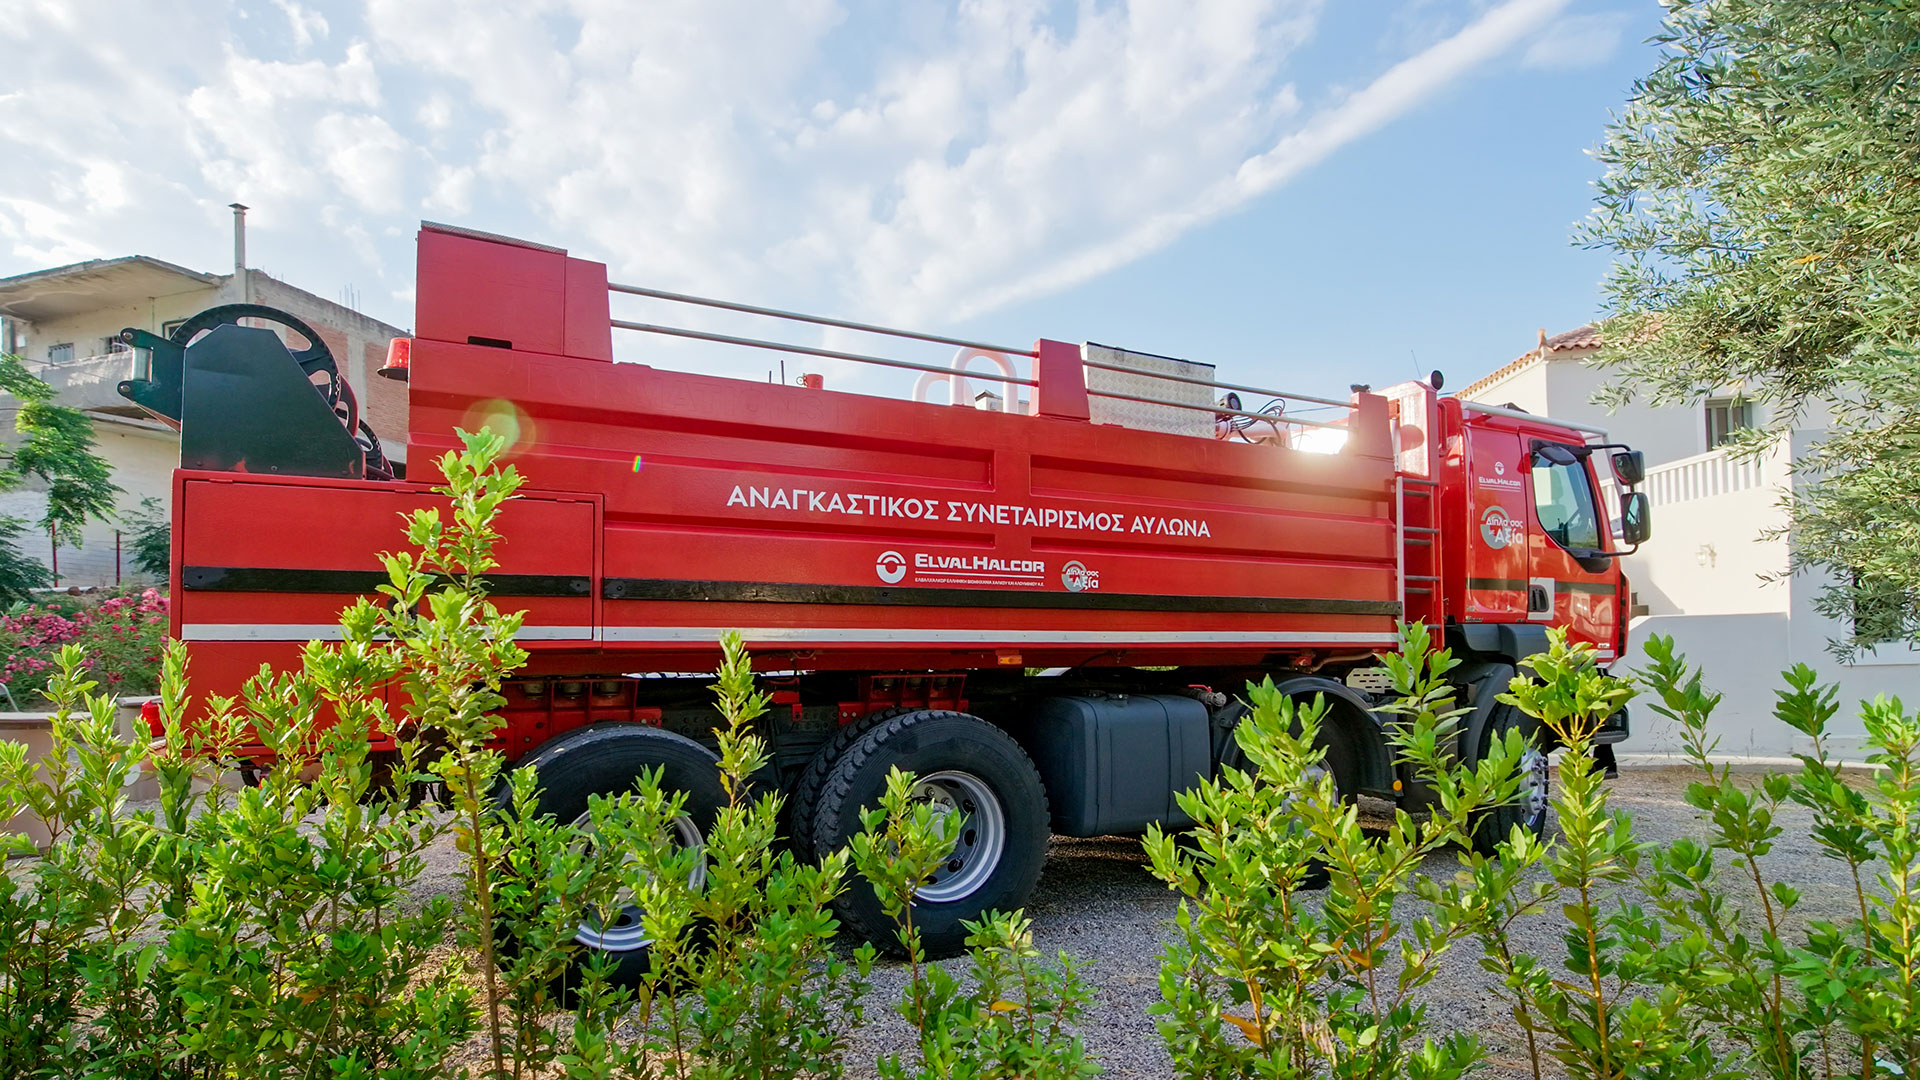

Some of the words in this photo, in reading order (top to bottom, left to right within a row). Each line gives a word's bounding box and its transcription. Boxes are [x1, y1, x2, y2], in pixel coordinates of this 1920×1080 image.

[726, 485, 940, 520] ΑΝΑΓΚΑΣΤΙΚΟΣ
[946, 501, 1125, 533] ΣΥΝΕΤΑΙΡΙΣΜΟΣ
[1130, 515, 1212, 538] ΑΥΛΩΝΑ
[1495, 527, 1524, 547] Αξία
[914, 553, 1045, 573] ELVALHALCOR
[1073, 576, 1099, 590] Αξία
